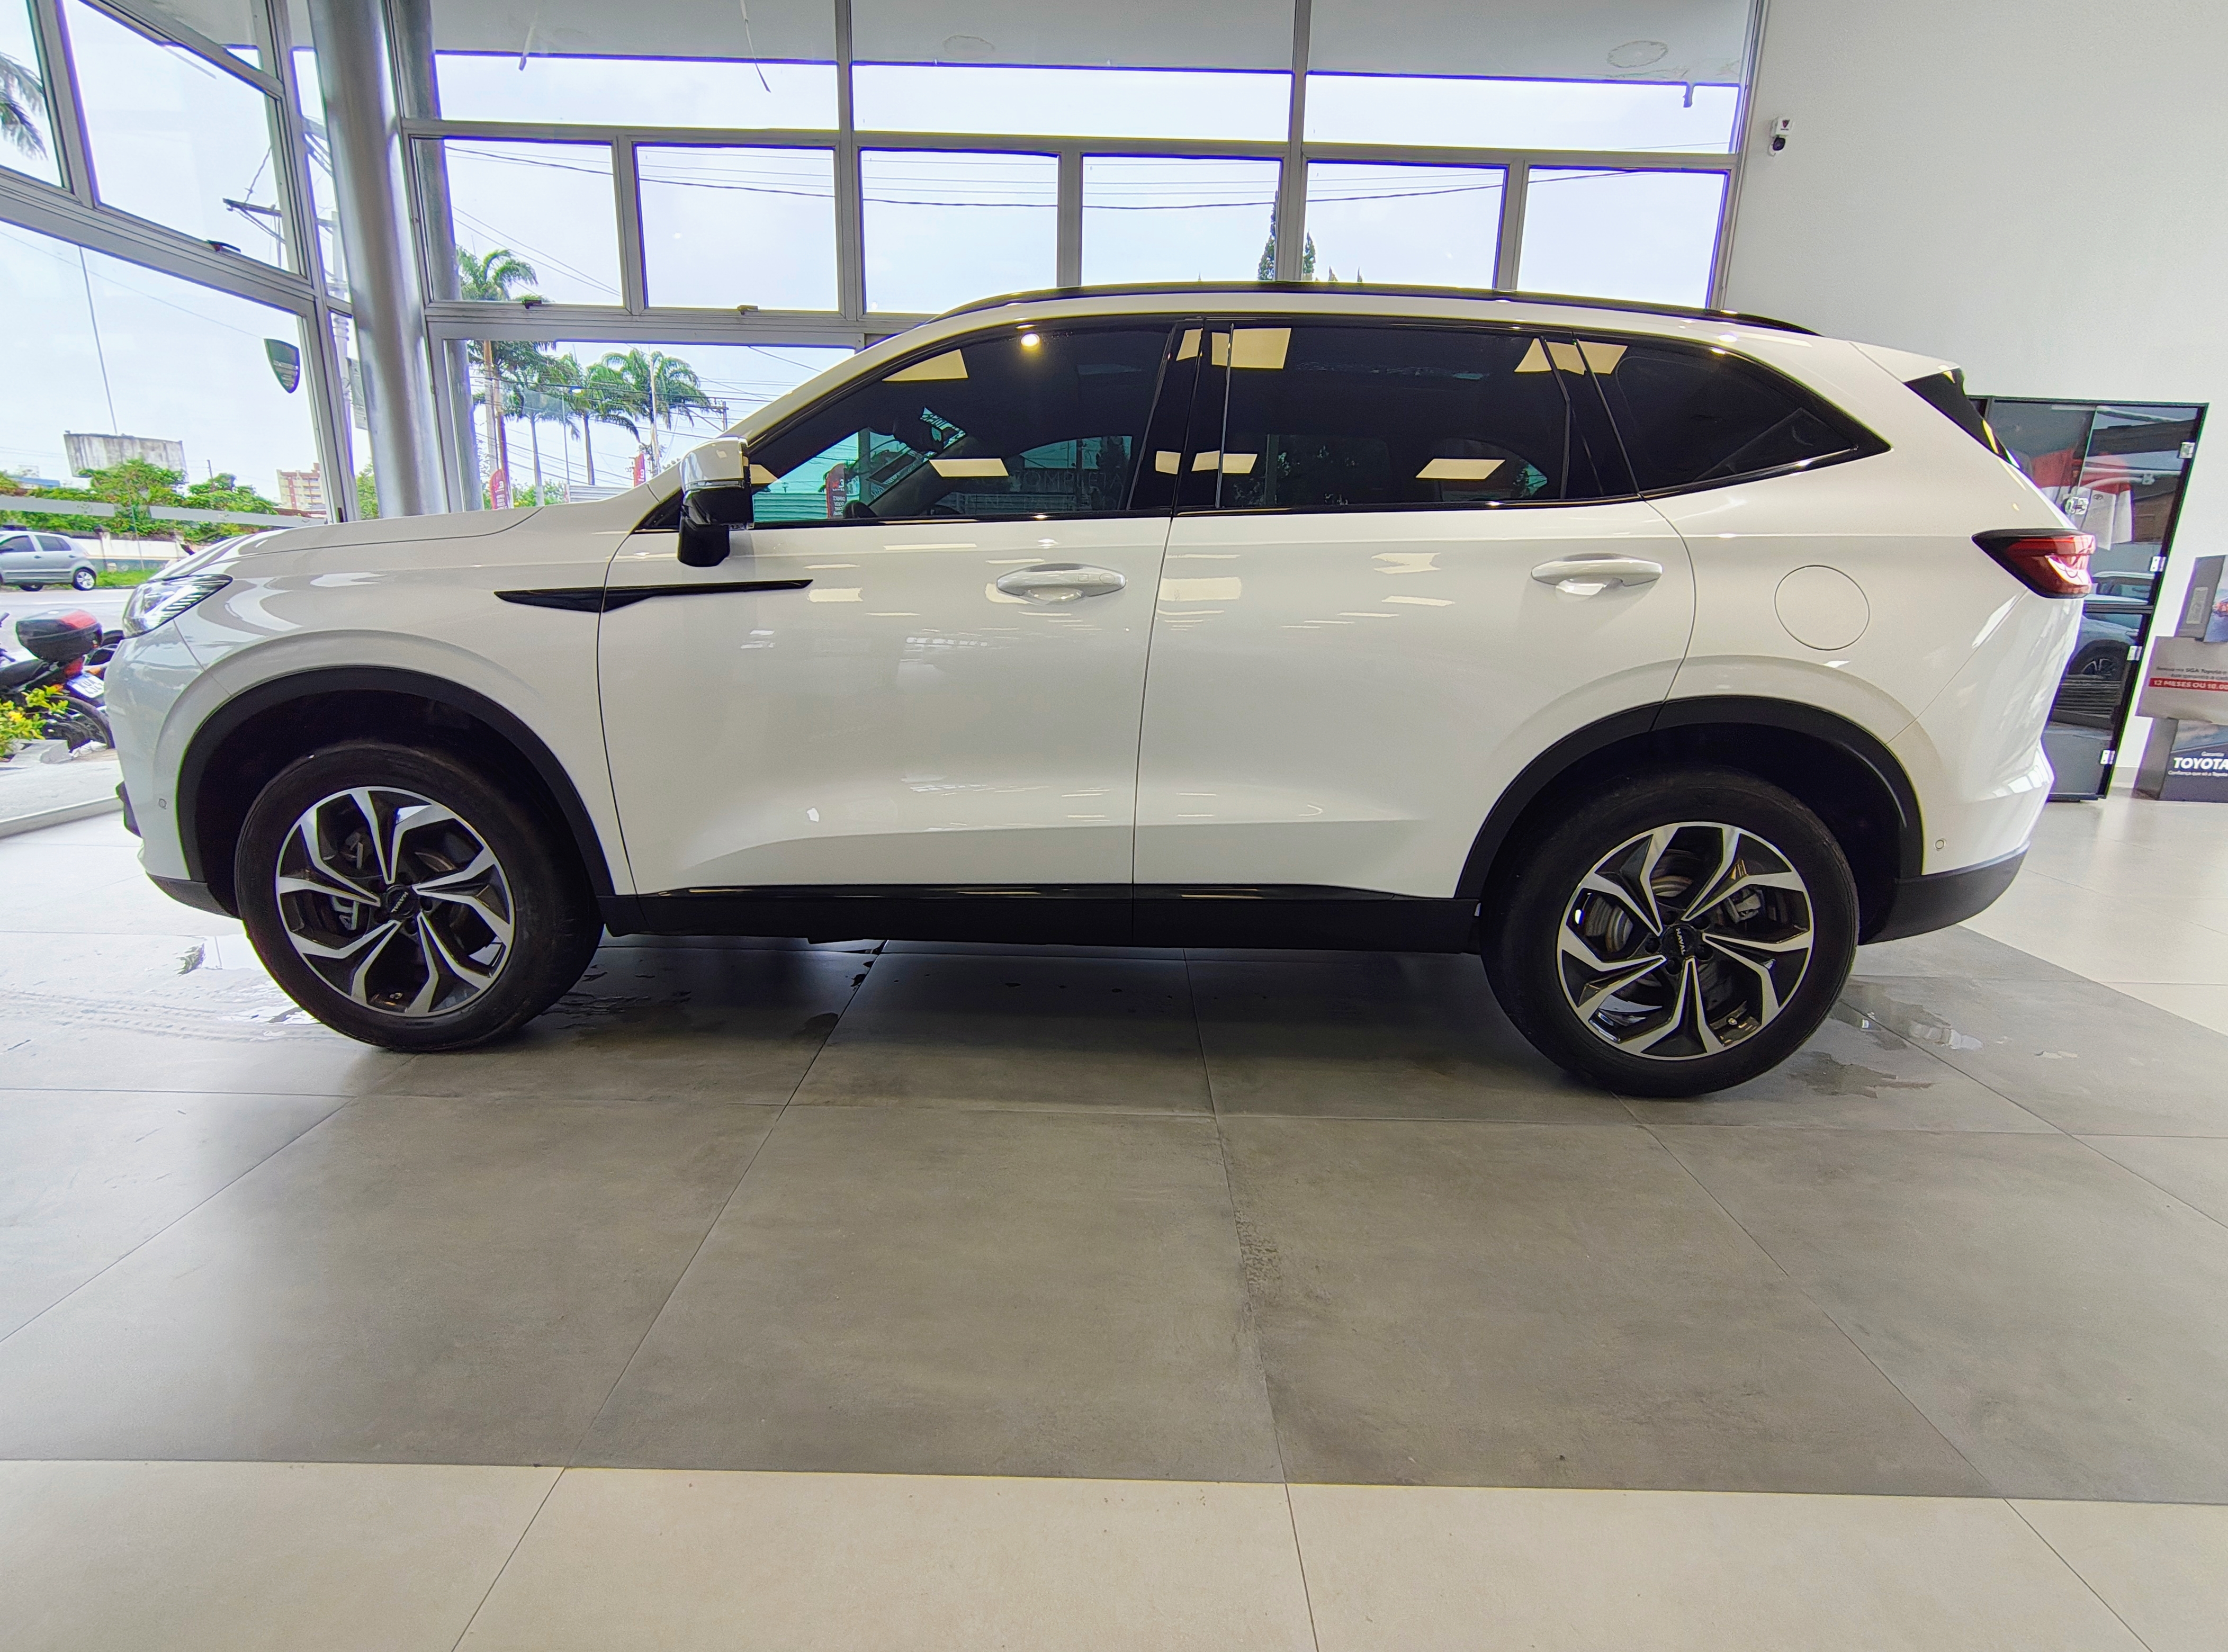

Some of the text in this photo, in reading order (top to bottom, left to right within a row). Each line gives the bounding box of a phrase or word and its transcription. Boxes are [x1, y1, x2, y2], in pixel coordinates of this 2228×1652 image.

[2173, 757, 2228, 770] TOYOTA
[391, 891, 409, 913] HAVAL
[1676, 928, 1686, 955] HAVAL
